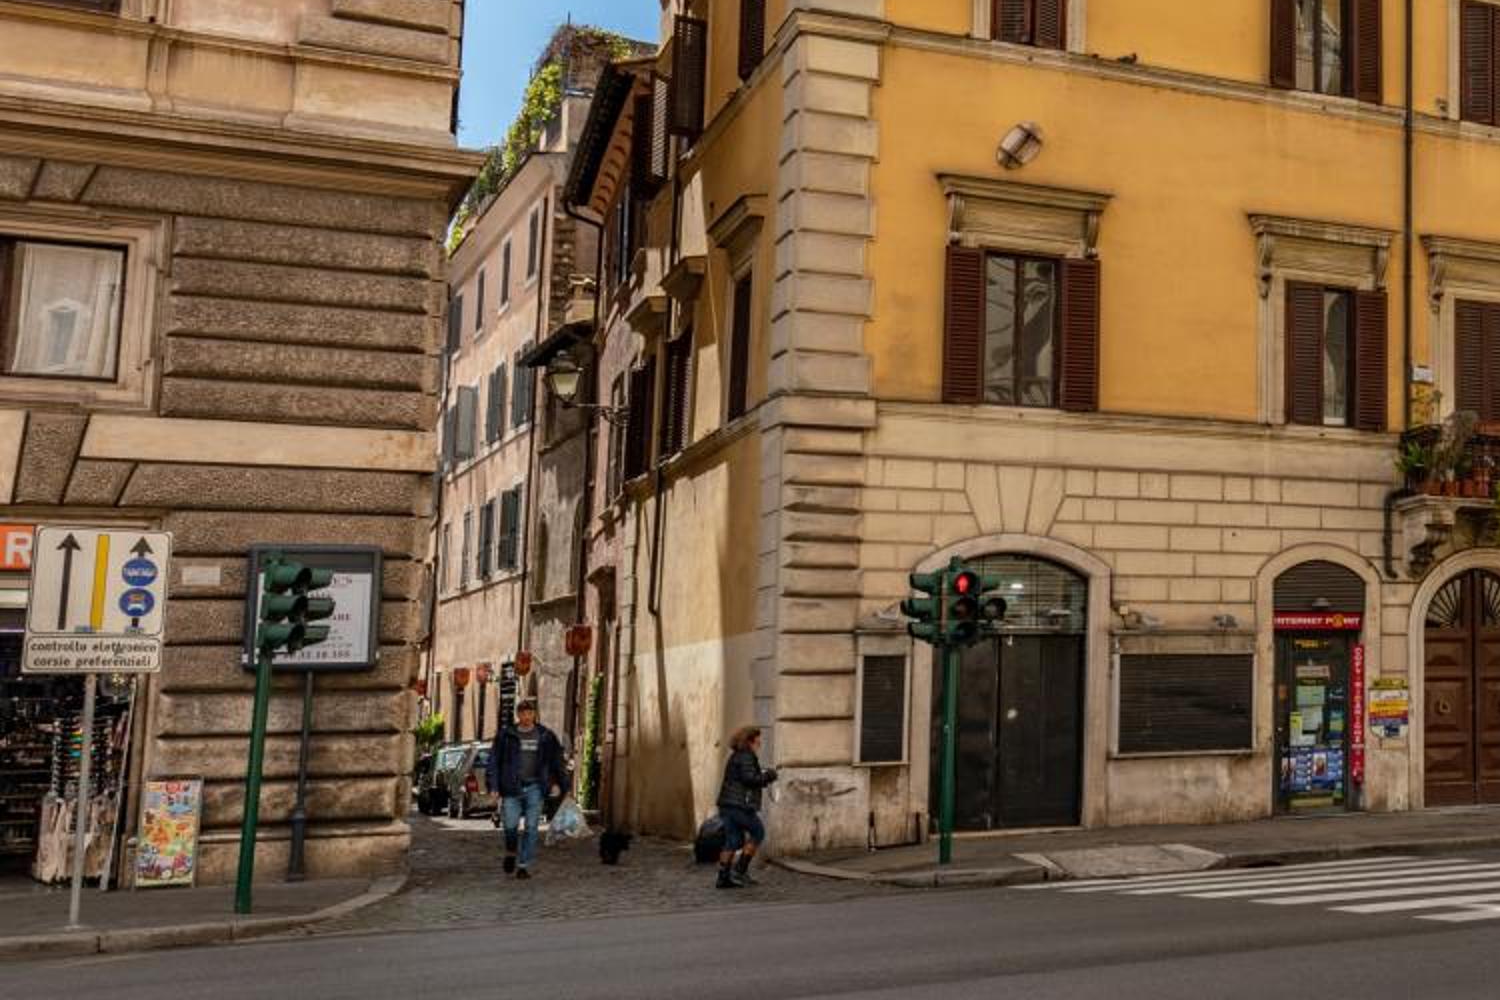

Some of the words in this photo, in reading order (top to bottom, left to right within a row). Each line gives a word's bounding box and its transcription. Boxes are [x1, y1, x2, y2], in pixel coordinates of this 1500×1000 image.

[1274, 617, 1323, 625] INTERNET
[30, 641, 87, 651] controllo
[33, 656, 70, 666] corsie
[75, 656, 151, 668] preferenziali
